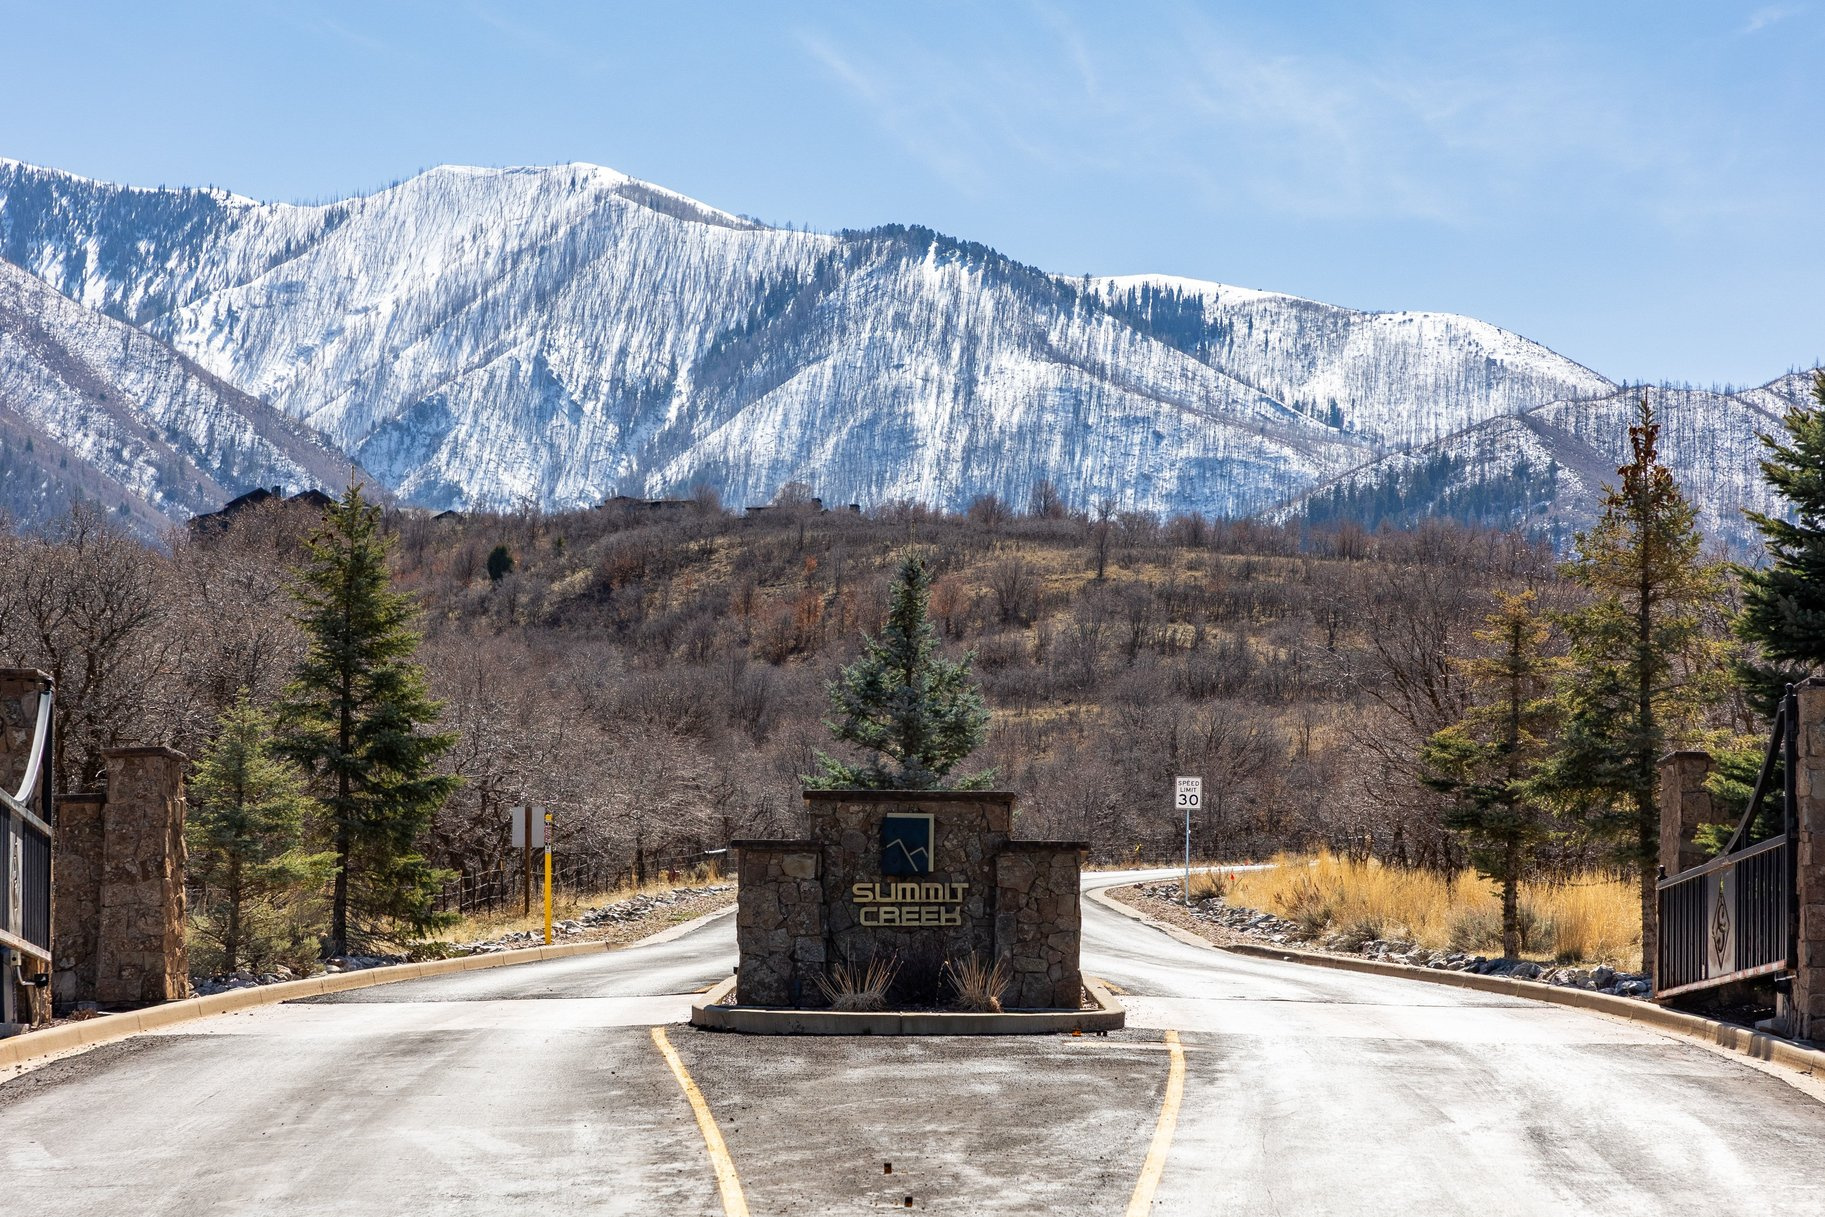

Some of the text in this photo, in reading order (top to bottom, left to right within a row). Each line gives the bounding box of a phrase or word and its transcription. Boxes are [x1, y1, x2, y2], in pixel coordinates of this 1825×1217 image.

[1178, 793, 1199, 806] 30
[852, 882, 969, 903] SUMMIT
[860, 906, 962, 926] CREEK
